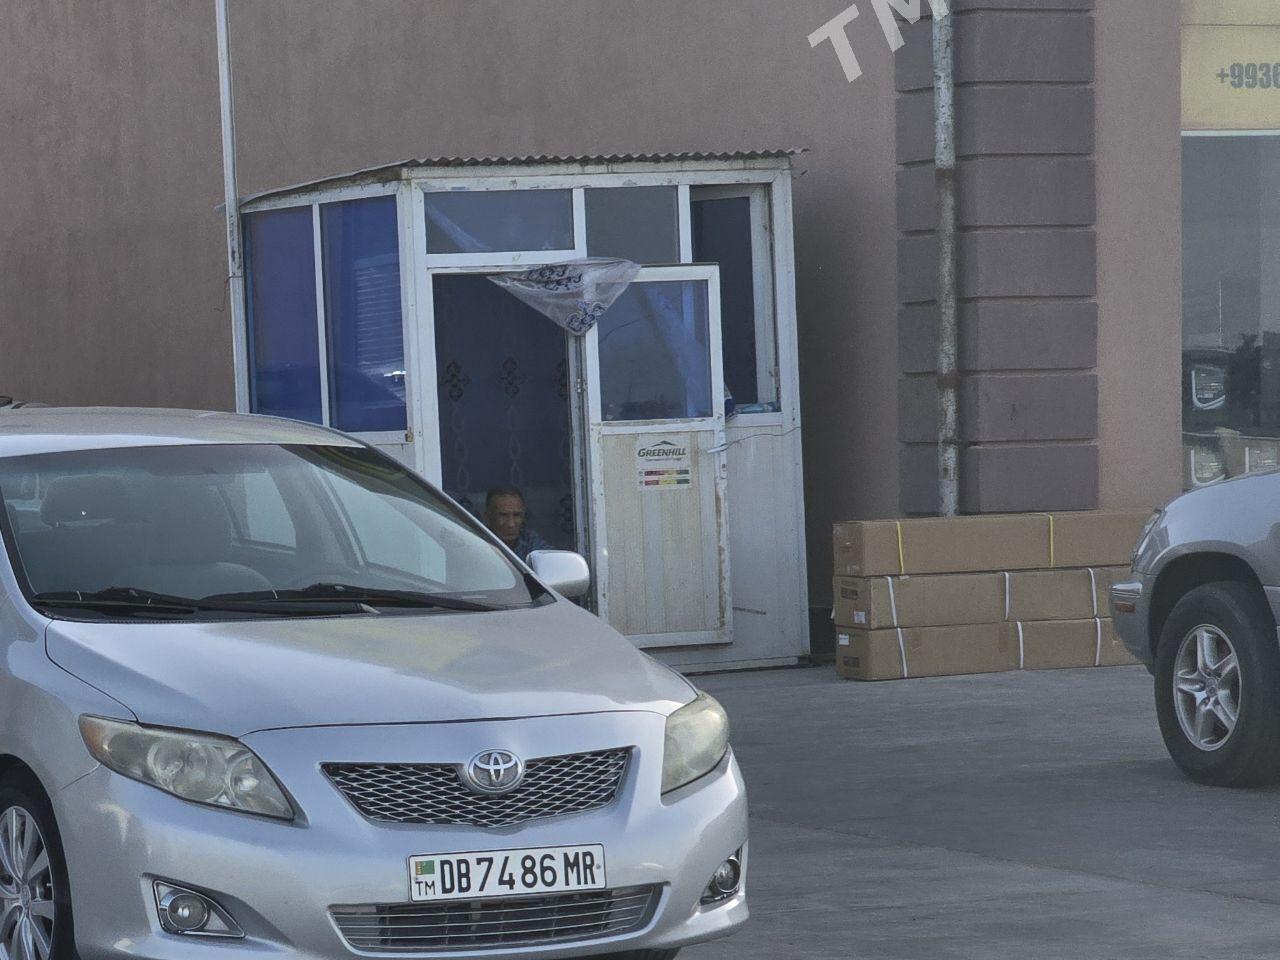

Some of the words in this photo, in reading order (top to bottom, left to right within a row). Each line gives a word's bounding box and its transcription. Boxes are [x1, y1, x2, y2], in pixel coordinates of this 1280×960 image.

[637, 447, 687, 457] GREENHILL
[439, 850, 597, 895] DB7486MR
[415, 880, 436, 897] TM
